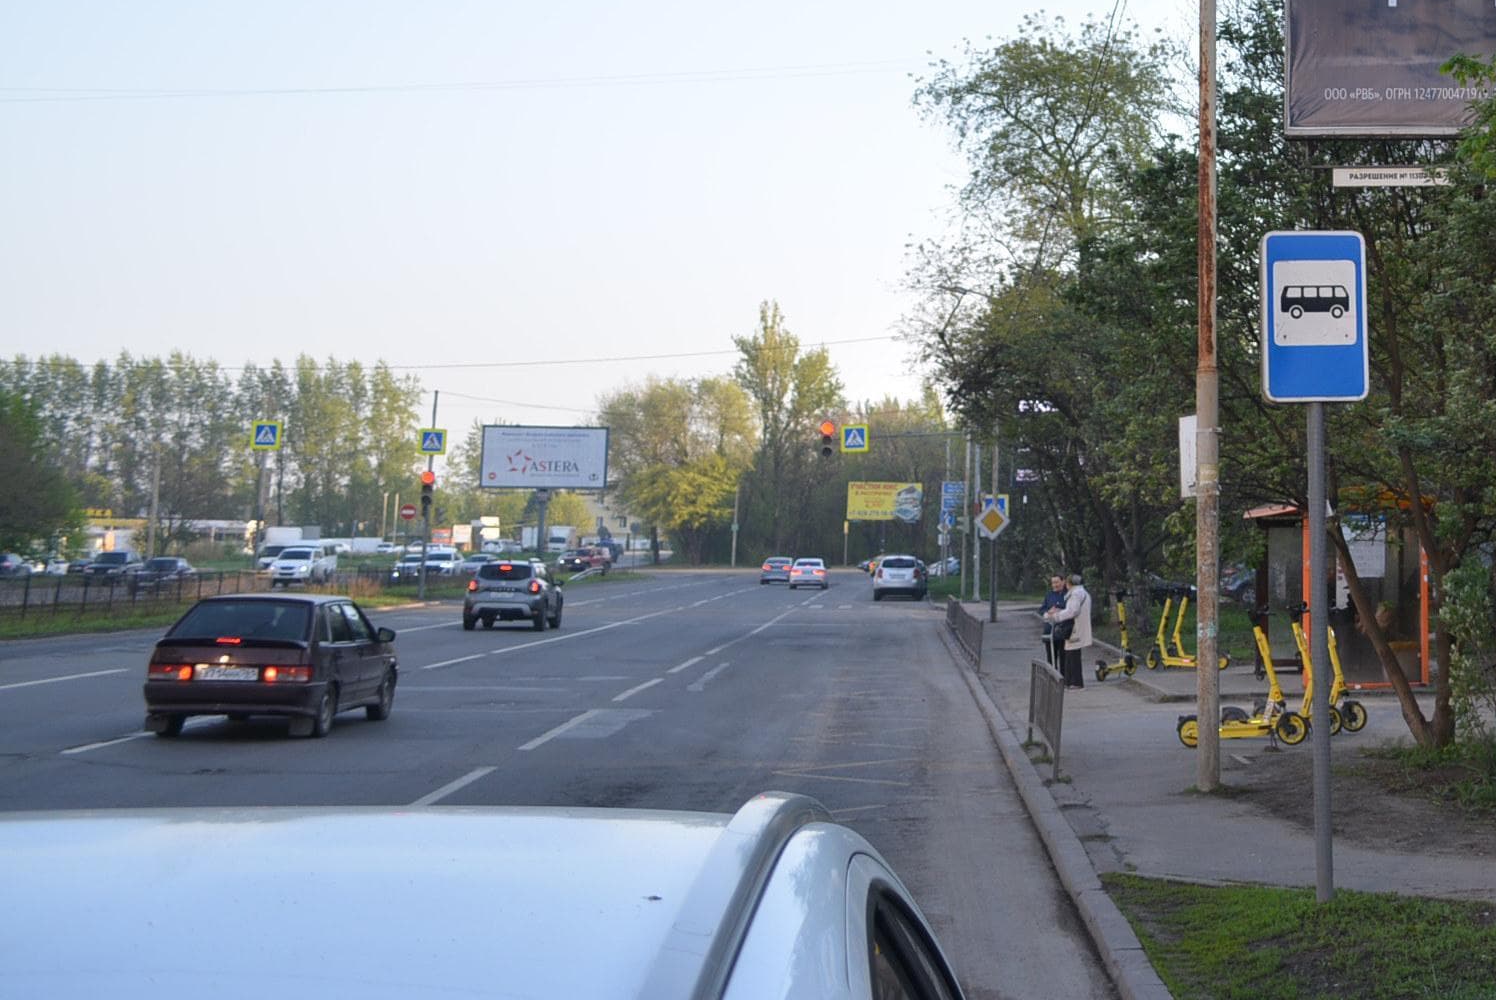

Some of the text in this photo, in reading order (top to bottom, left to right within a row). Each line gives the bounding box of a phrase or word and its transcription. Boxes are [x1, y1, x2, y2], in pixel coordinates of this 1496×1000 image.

[1324, 87, 1348, 100] ООО
[1385, 87, 1412, 100] ОГРН
[1349, 172, 1398, 181] РАЗРЕШЕНИЕ
[530, 460, 580, 473] ASTERA
